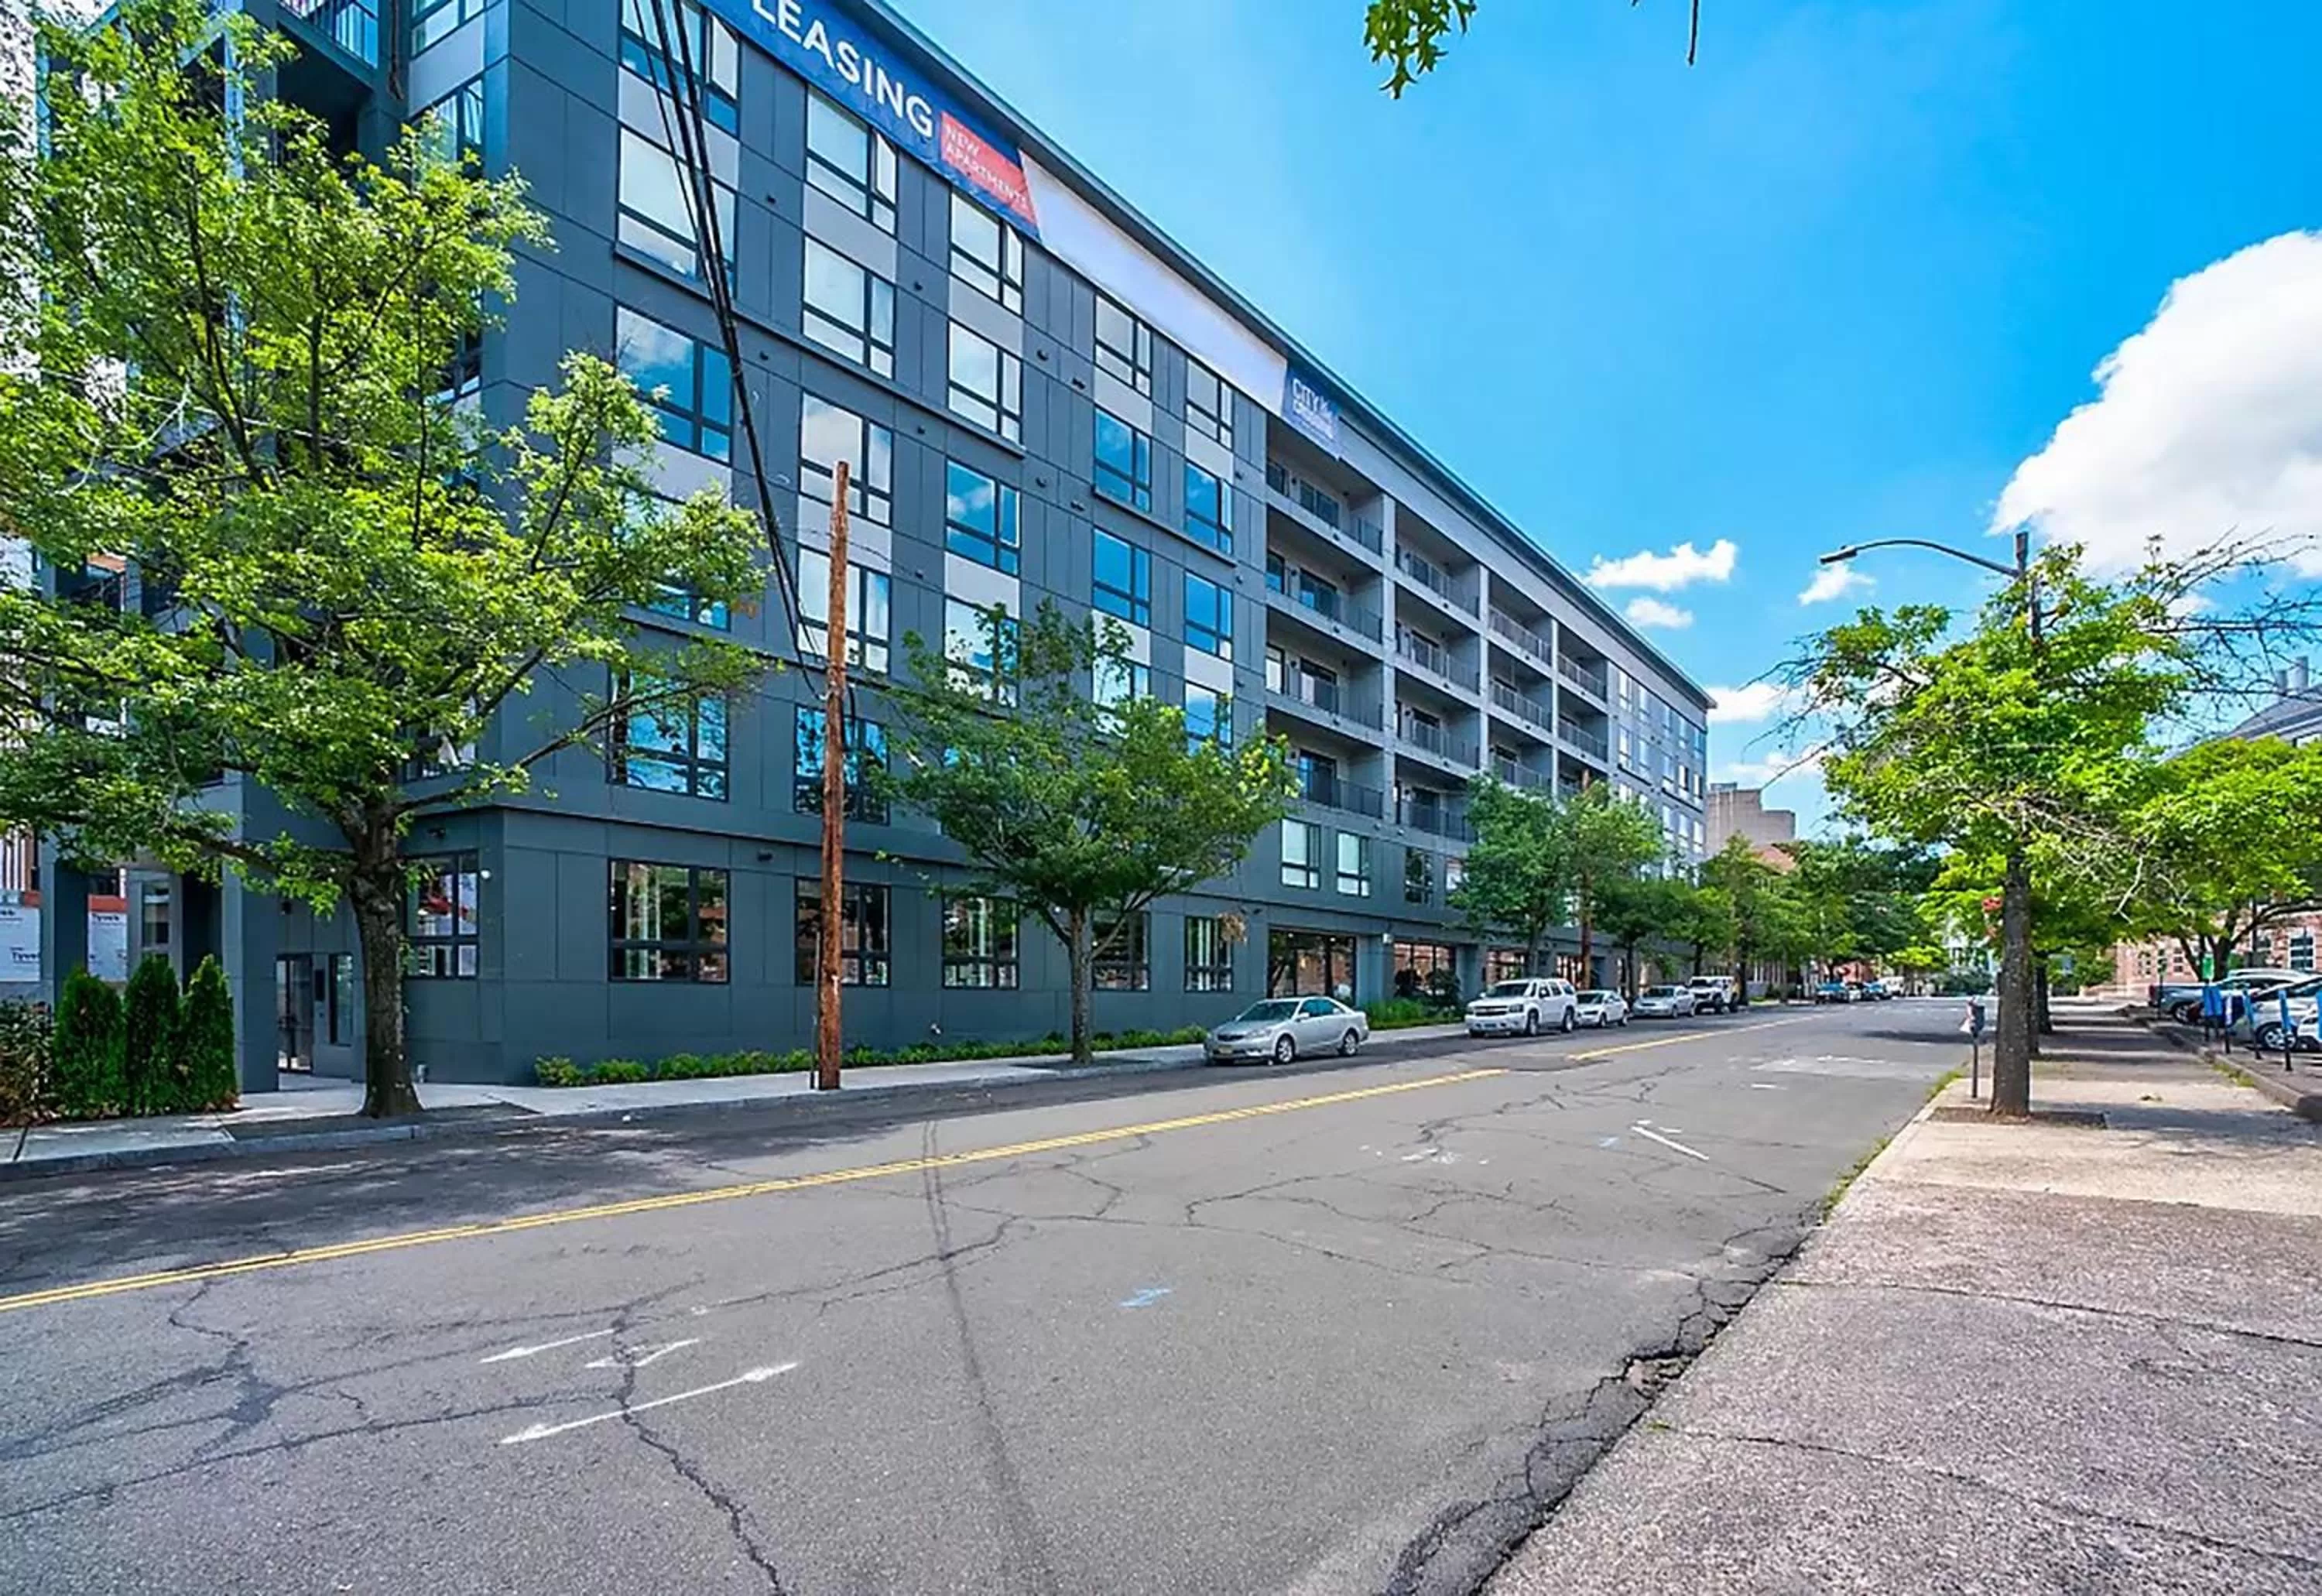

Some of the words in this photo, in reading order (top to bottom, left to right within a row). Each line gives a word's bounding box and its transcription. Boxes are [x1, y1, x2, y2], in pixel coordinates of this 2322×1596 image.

[753, 0, 933, 138] LEASING
[943, 123, 979, 156] NEW
[946, 142, 1027, 207] APARTMENTS
